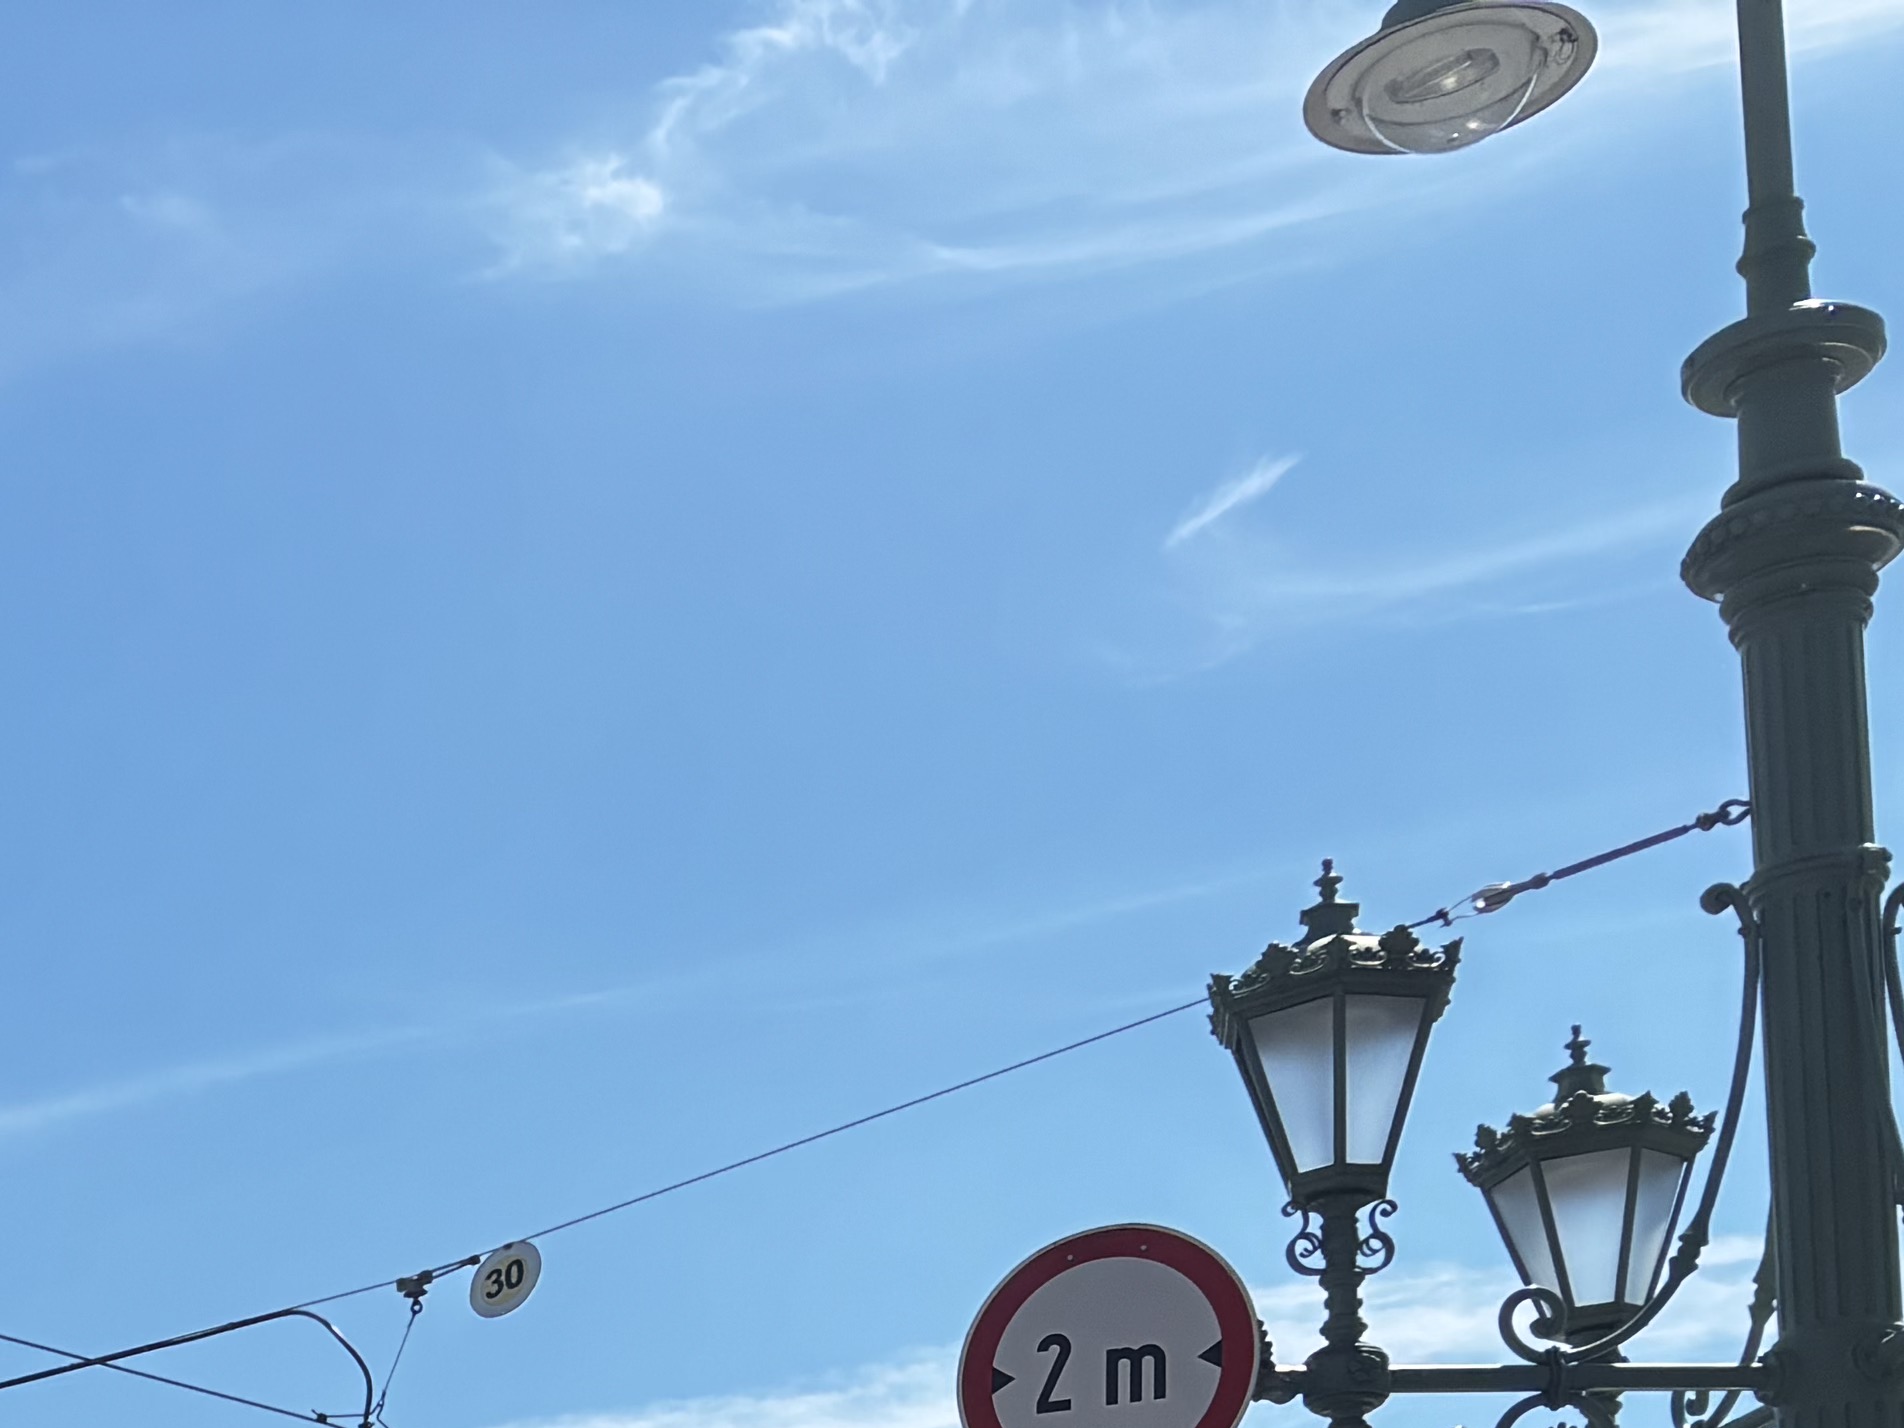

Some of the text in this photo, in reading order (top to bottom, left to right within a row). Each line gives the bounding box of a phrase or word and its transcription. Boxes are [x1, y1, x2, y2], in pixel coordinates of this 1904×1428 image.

[484, 1258, 525, 1300] 30
[1036, 1333, 1167, 1415] 2 m
